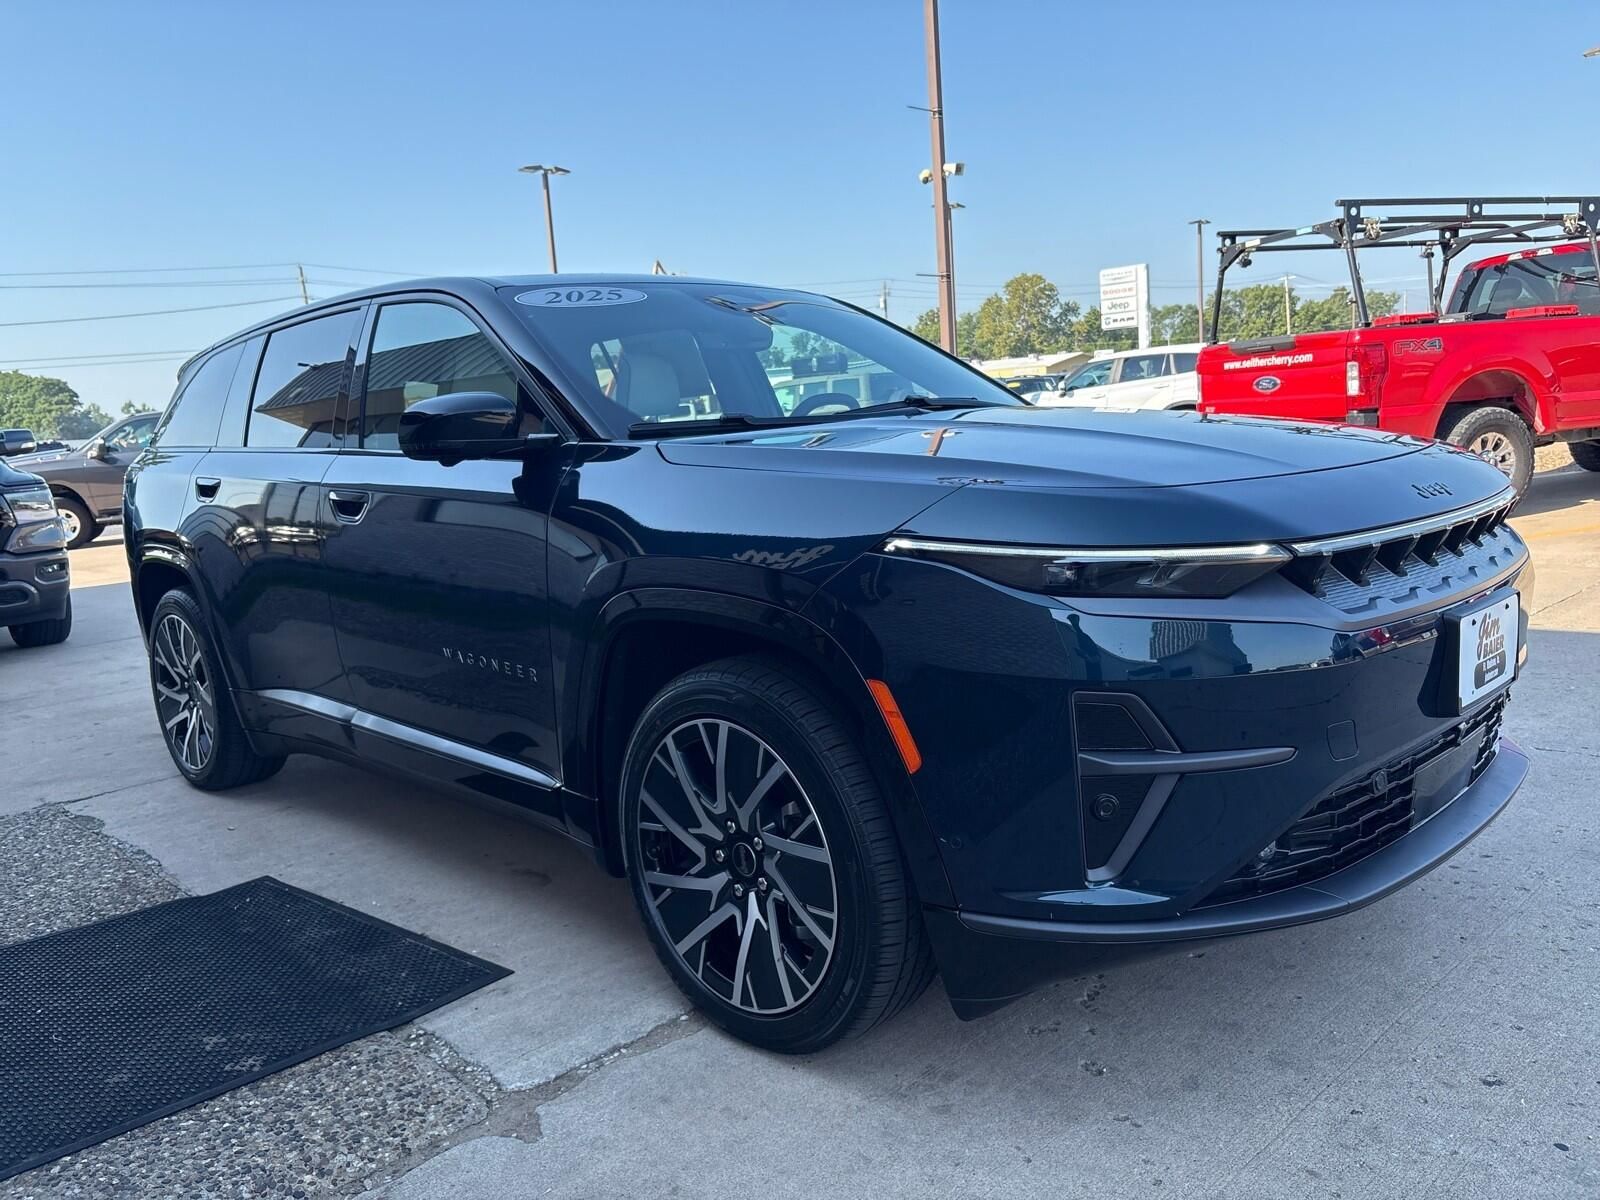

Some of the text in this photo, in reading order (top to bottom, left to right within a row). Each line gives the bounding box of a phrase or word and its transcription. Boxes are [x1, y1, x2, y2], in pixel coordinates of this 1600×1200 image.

[545, 289, 623, 304] 2025
[1107, 301, 1130, 311] Jeep
[1393, 337, 1443, 356] FX4
[1477, 612, 1501, 661] Jim
[1483, 634, 1505, 659] BAIER
[442, 647, 538, 682] WAGONEER
